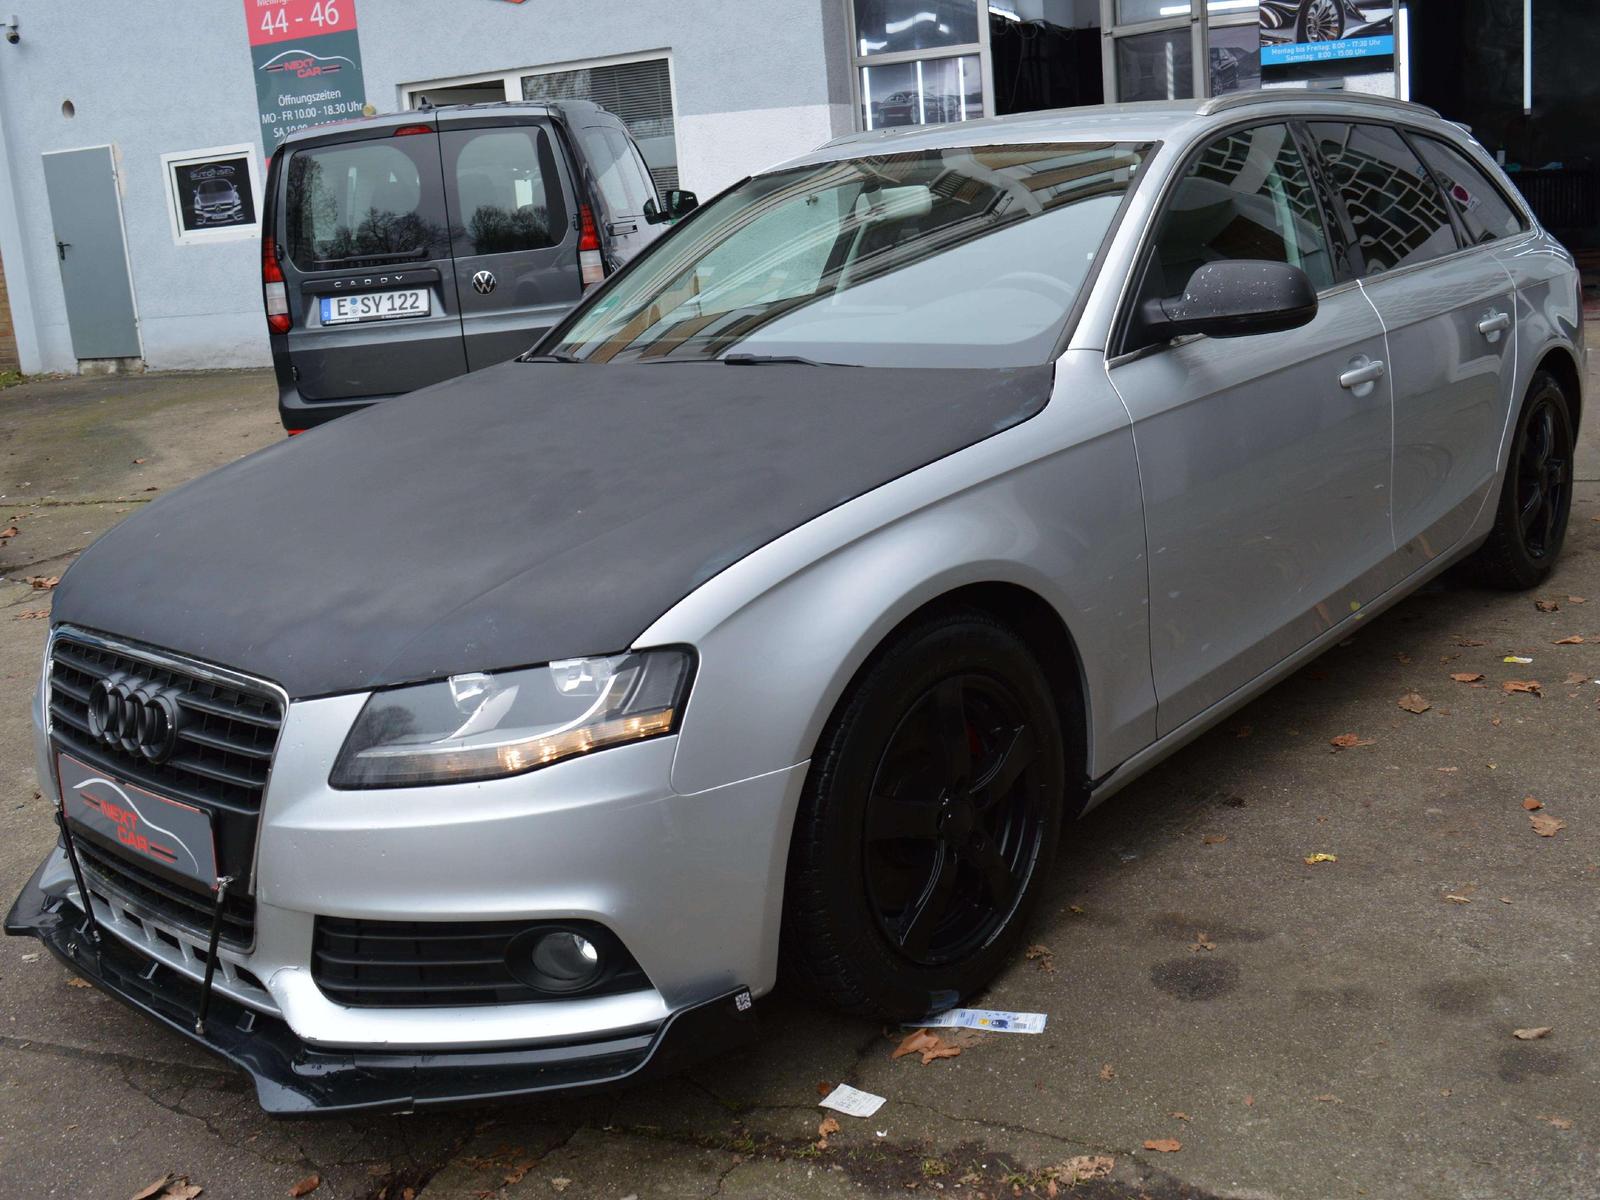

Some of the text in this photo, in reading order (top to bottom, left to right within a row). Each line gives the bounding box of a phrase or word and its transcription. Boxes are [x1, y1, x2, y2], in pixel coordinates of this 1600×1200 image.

[261, 8, 288, 35] 44
[310, 0, 339, 27] 46
[1272, 47, 1294, 56] Montag
[1295, 45, 1305, 53] bis
[283, 58, 314, 71] NEXT
[297, 66, 321, 78] CAR
[278, 90, 341, 106] Öffnungszeiten
[261, 113, 276, 124] MO
[282, 111, 293, 121] FR
[295, 107, 316, 119] 10.00
[323, 103, 346, 115] 18.30
[347, 101, 363, 112] Uhr
[273, 127, 285, 138] SA
[334, 275, 403, 288] CADDY
[337, 292, 420, 317] E SY 122
[100, 800, 139, 830] NEXT
[117, 825, 149, 853] CAR
